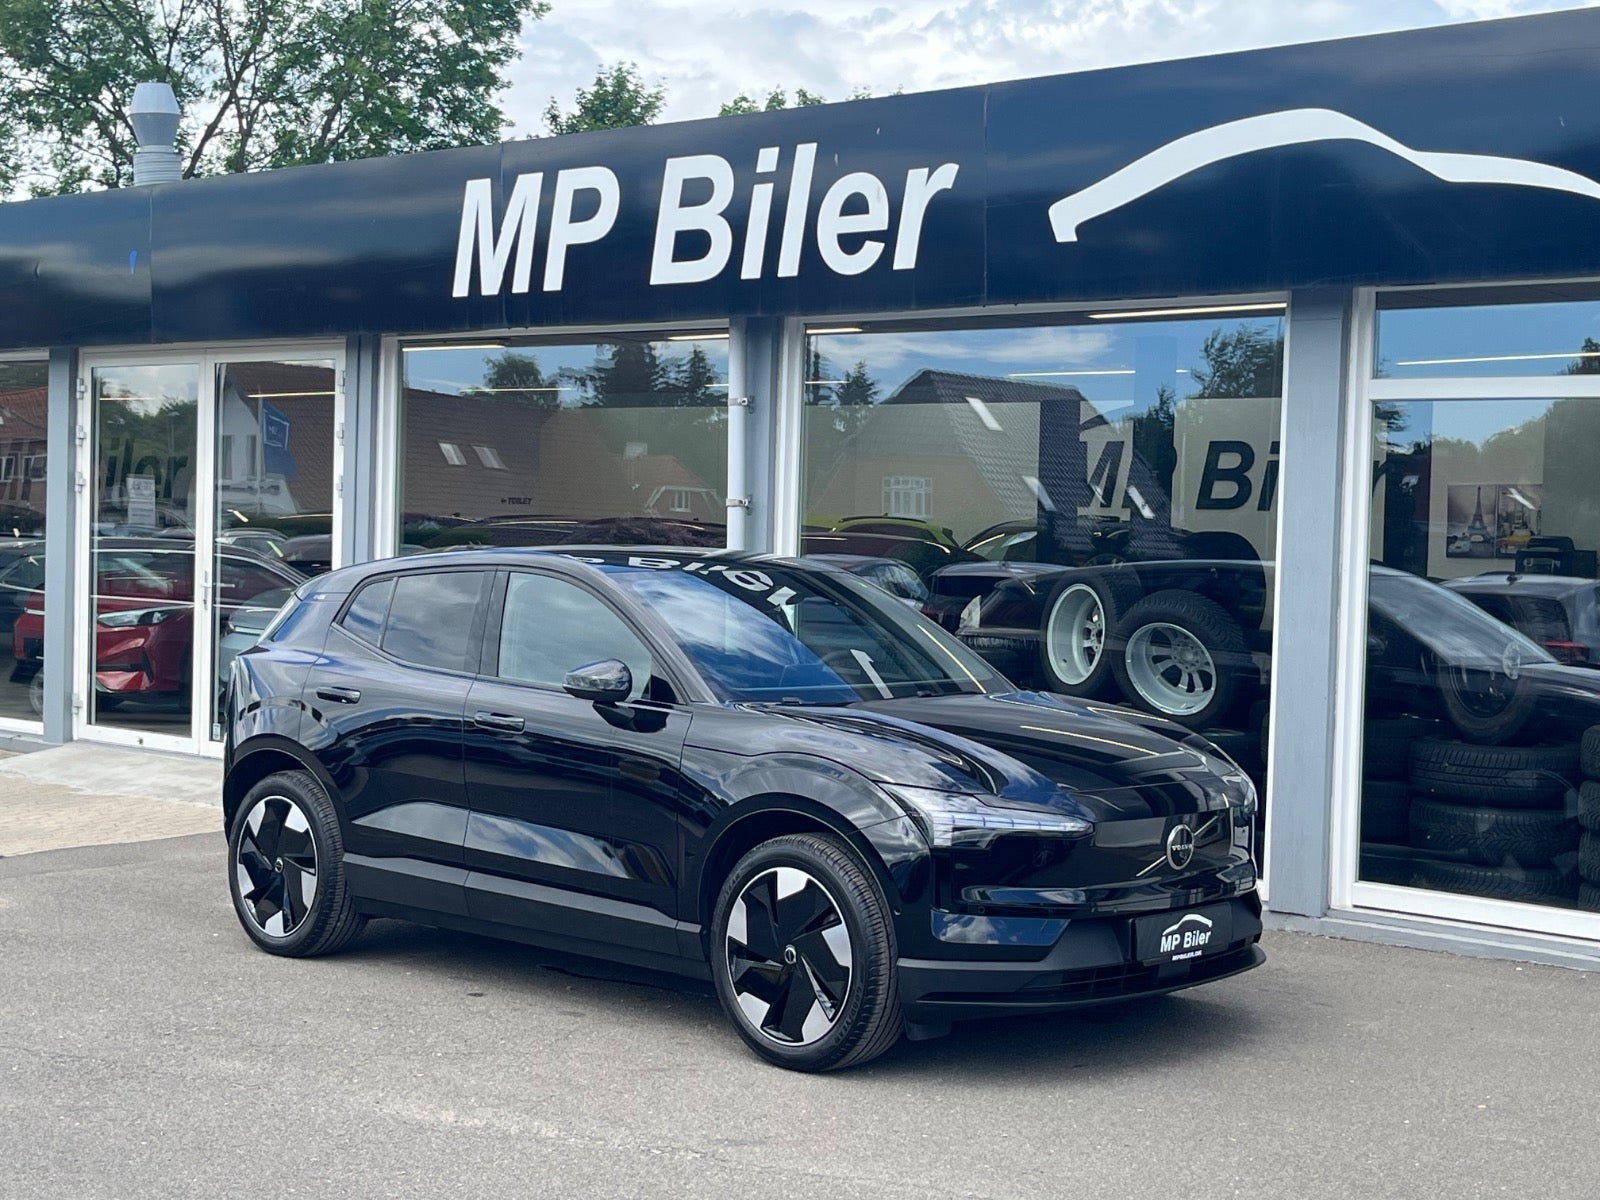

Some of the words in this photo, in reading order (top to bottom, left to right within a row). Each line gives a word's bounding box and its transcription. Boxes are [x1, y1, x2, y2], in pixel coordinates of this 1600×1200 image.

[452, 165, 620, 297] MP
[649, 142, 959, 286] Biler
[1160, 935, 1180, 953] MP
[1183, 930, 1211, 948] Biler
